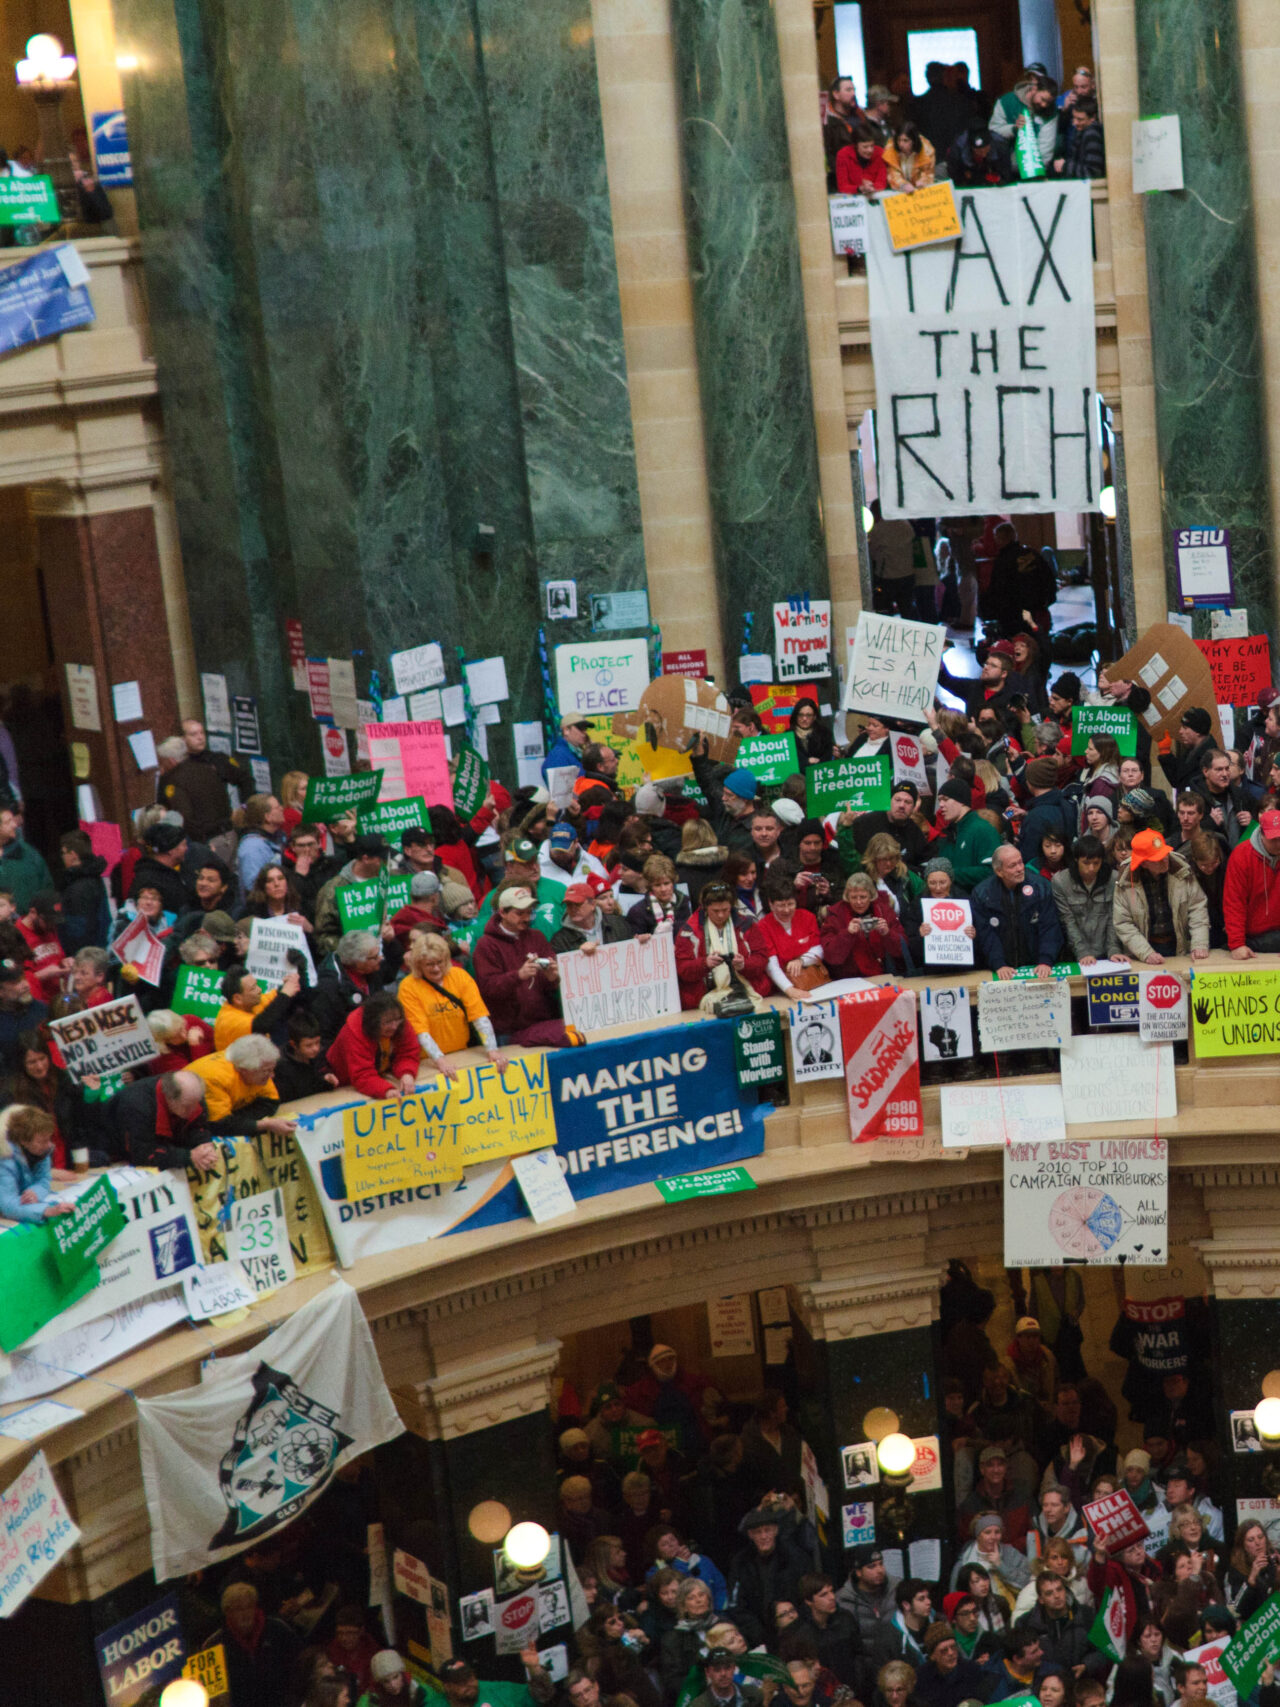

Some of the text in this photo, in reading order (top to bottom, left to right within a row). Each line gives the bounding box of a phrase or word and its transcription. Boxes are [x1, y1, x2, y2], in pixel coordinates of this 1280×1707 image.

[919, 326, 1047, 378] THE
[891, 386, 1093, 508] RICH
[1178, 530, 1225, 546] SEIU
[776, 610, 828, 628] Warning
[866, 622, 937, 657] WALKER
[1201, 646, 1233, 657] WHY
[571, 654, 634, 672] PROJECT
[666, 661, 704, 671] RELIGIONS
[781, 660, 794, 676] in
[868, 656, 917, 680] IS A
[1233, 662, 1246, 671] BE
[852, 676, 930, 710] KOCH-HEAD
[1218, 684, 1247, 692] WITH
[576, 688, 629, 709] PEACE
[1078, 710, 1132, 723] It's About
[1077, 722, 1131, 735] Freedom!
[749, 738, 789, 752] About
[896, 742, 919, 760] STOP
[813, 762, 883, 781] It's About
[316, 776, 377, 792] It's About
[814, 772, 883, 794] Freedom!
[313, 786, 375, 804] Freedom!
[380, 803, 419, 818] About
[362, 815, 422, 835] Freedom!
[931, 909, 963, 922] STOP
[257, 925, 300, 940] WISCONSIN
[943, 934, 967, 943] ATTACK
[937, 944, 971, 952] WISCONSIN
[936, 953, 964, 961] FAMILIES
[560, 935, 670, 1000] IMPEACH
[186, 972, 210, 988] It's
[1090, 976, 1123, 986] ONE
[1198, 975, 1229, 990] Scott
[1148, 985, 1180, 999] STOP
[1213, 995, 1269, 1019] HANDS
[799, 1013, 827, 1022] GET
[1151, 1031, 1178, 1039] FAMILIES
[743, 1039, 775, 1055] Stands
[71, 1039, 156, 1079] WALKERVILLE
[750, 1052, 771, 1068] with
[559, 1048, 708, 1102] MAKING
[739, 1065, 782, 1083] Workers
[796, 1063, 842, 1074] SHORTY
[353, 1093, 450, 1137] UFCW
[596, 1084, 680, 1130] THE
[885, 1100, 917, 1116] 1980
[884, 1117, 918, 1132] 1990
[356, 1134, 406, 1158] LOCAL
[555, 1109, 745, 1175] DIFFERENCE!
[1006, 1141, 1167, 1162] WHY BUST UNIONS?
[1037, 1161, 1128, 1173] 2010 TOP 10
[1010, 1174, 1081, 1188] CAMPAIGN
[1137, 1200, 1159, 1211] ALL
[1136, 1211, 1167, 1226] UNIONS!
[58, 1201, 112, 1254] Freedom!
[240, 1220, 274, 1252] 33
[200, 1288, 248, 1313] LABOR
[1126, 1301, 1185, 1322] STOP
[1137, 1331, 1180, 1348] WAR
[845, 1503, 868, 1516] WE
[1089, 1494, 1129, 1522] KILL
[503, 1600, 535, 1625] STOP
[1243, 1602, 1280, 1640] About
[103, 1608, 178, 1666] HONOR
[106, 1639, 183, 1697] LABOR
[189, 1650, 216, 1676] FOR
